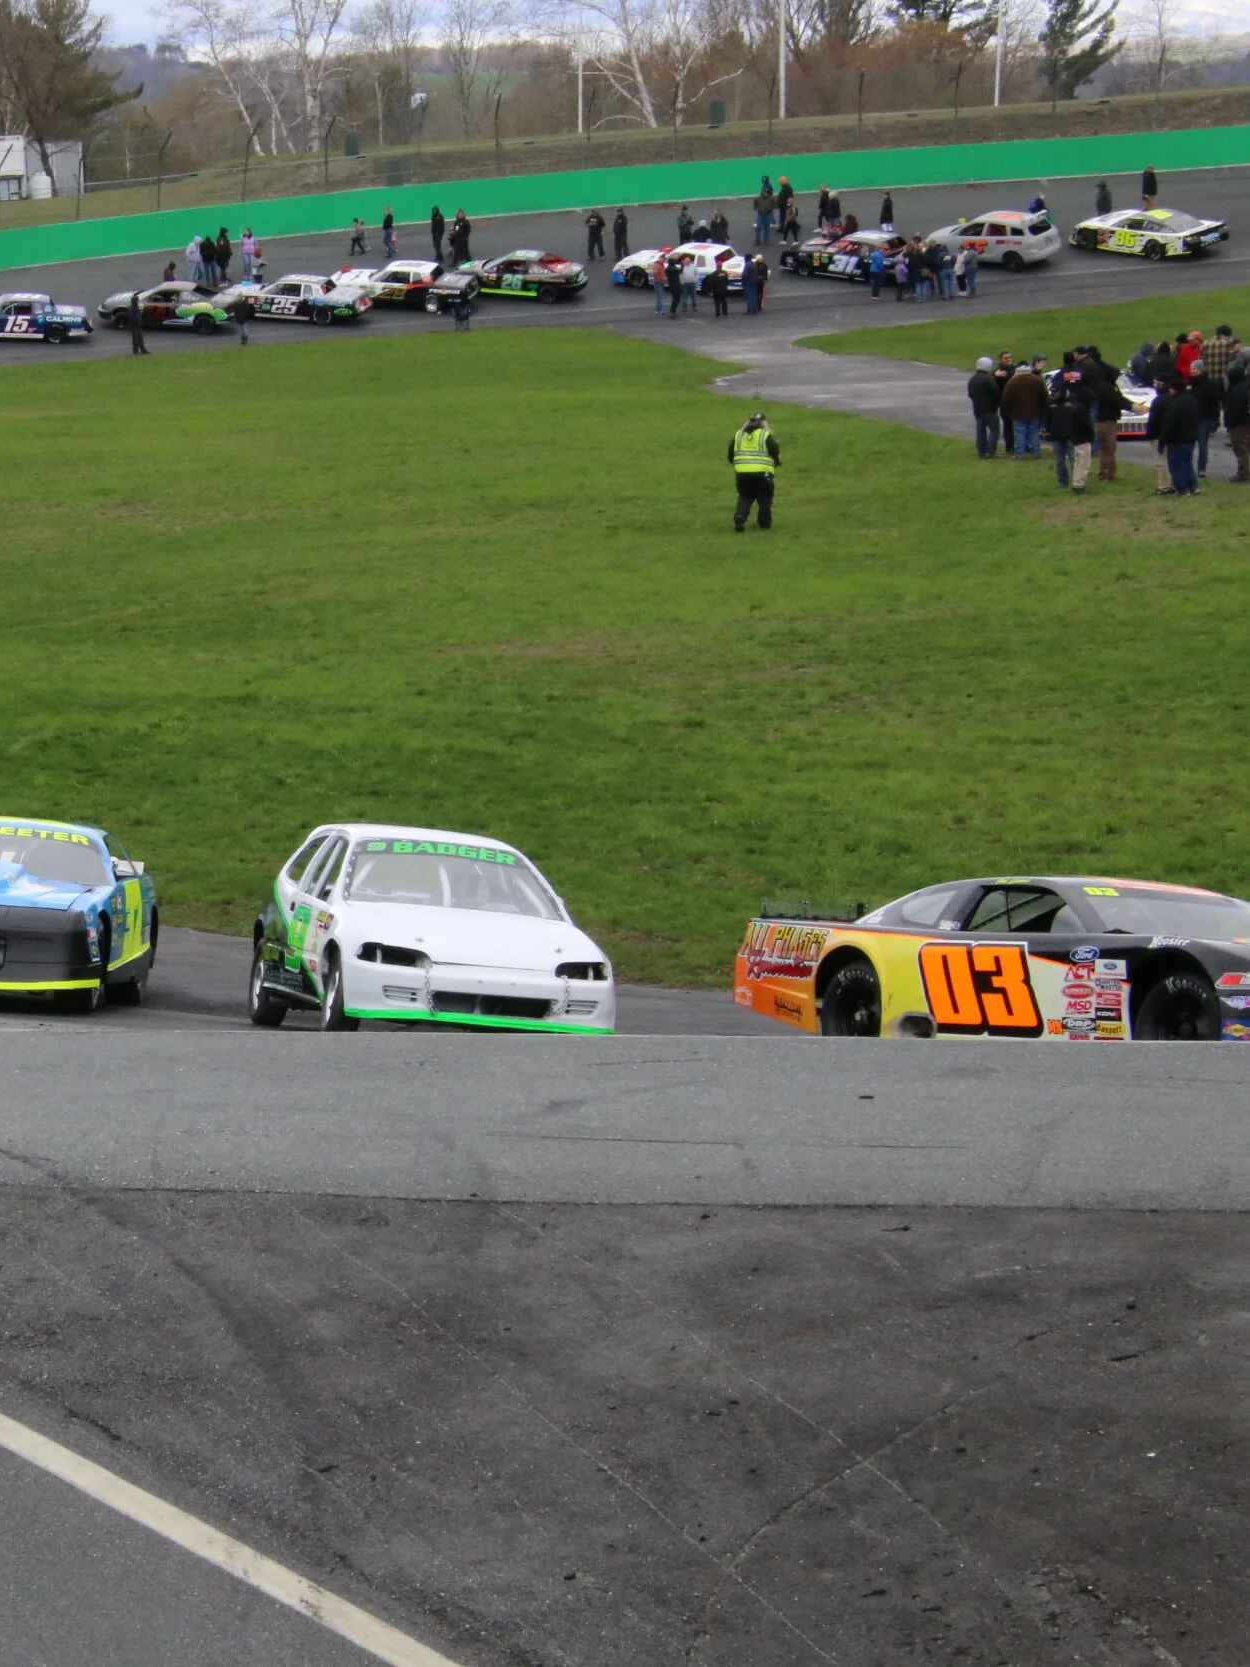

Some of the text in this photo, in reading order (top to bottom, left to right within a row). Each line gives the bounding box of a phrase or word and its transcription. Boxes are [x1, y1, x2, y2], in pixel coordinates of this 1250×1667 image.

[270, 297, 299, 315] 25
[4, 315, 31, 332] 15
[367, 841, 516, 865] 9 BADGER
[771, 925, 830, 962] PHASES
[1074, 948, 1095, 959] Ford
[919, 942, 1043, 1038] 03
[1066, 1000, 1092, 1011] MSD
